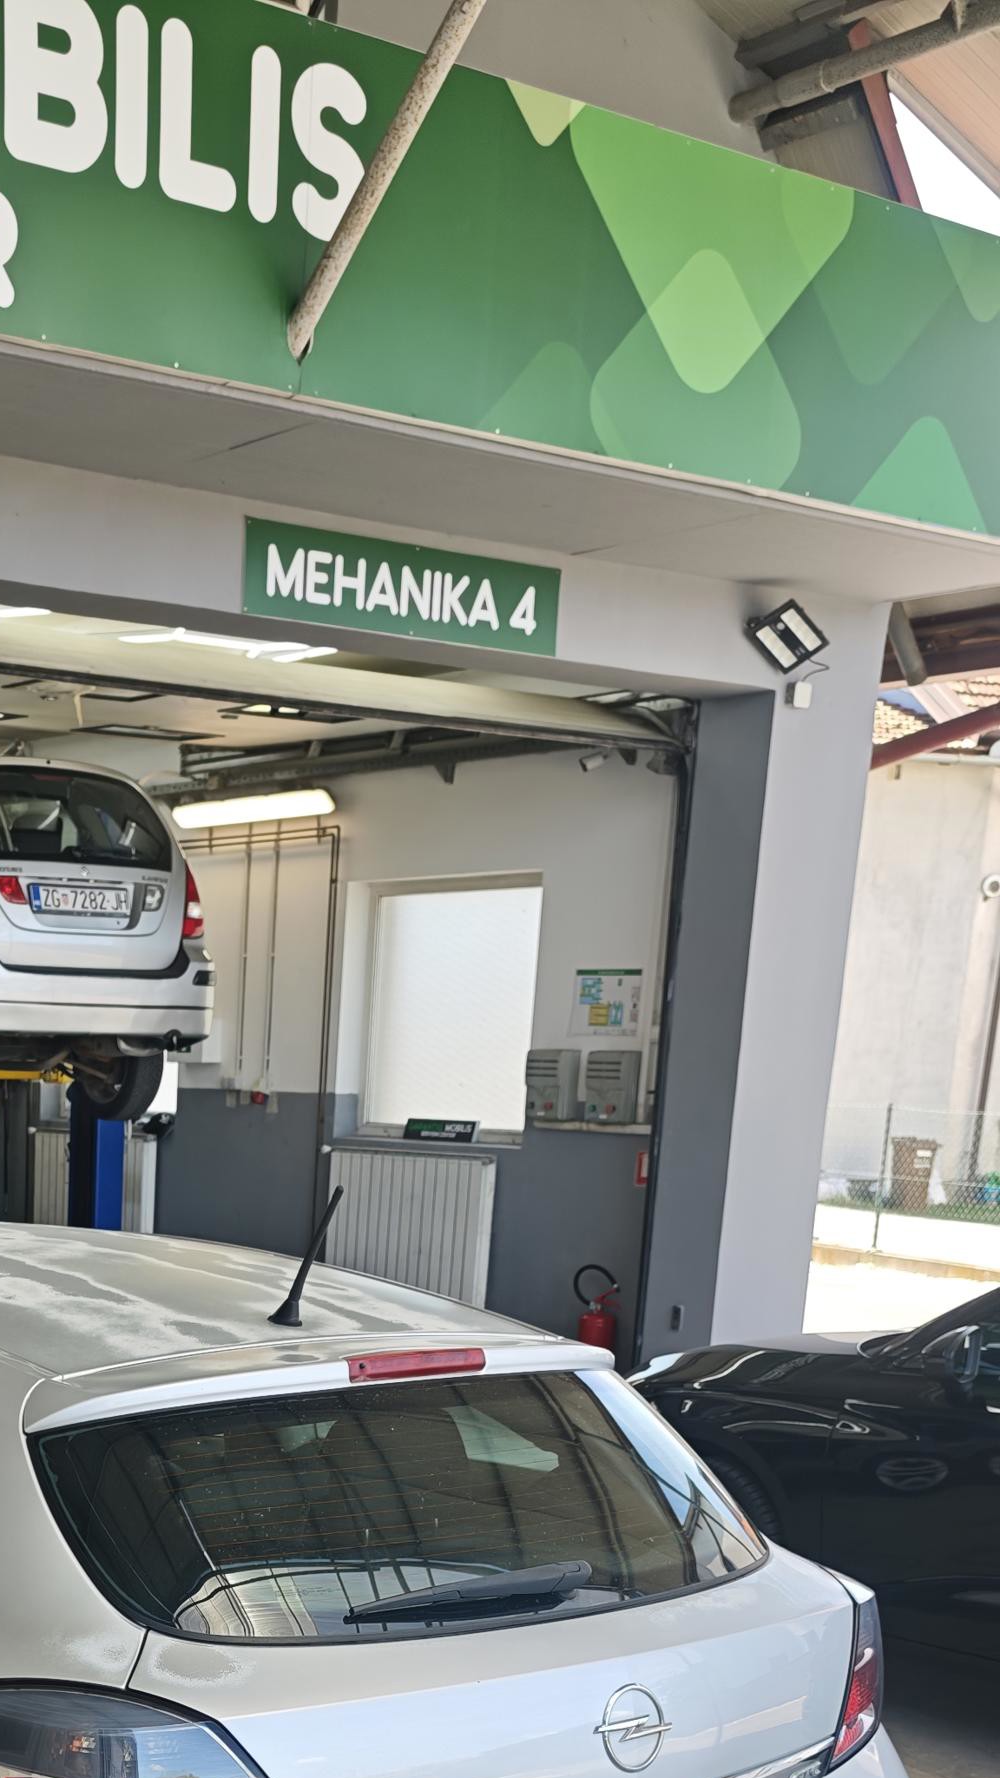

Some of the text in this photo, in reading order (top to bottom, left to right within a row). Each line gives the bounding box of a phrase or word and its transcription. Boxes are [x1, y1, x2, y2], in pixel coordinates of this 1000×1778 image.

[266, 543, 537, 636] MEHANIKA 4
[42, 888, 61, 908] ZG
